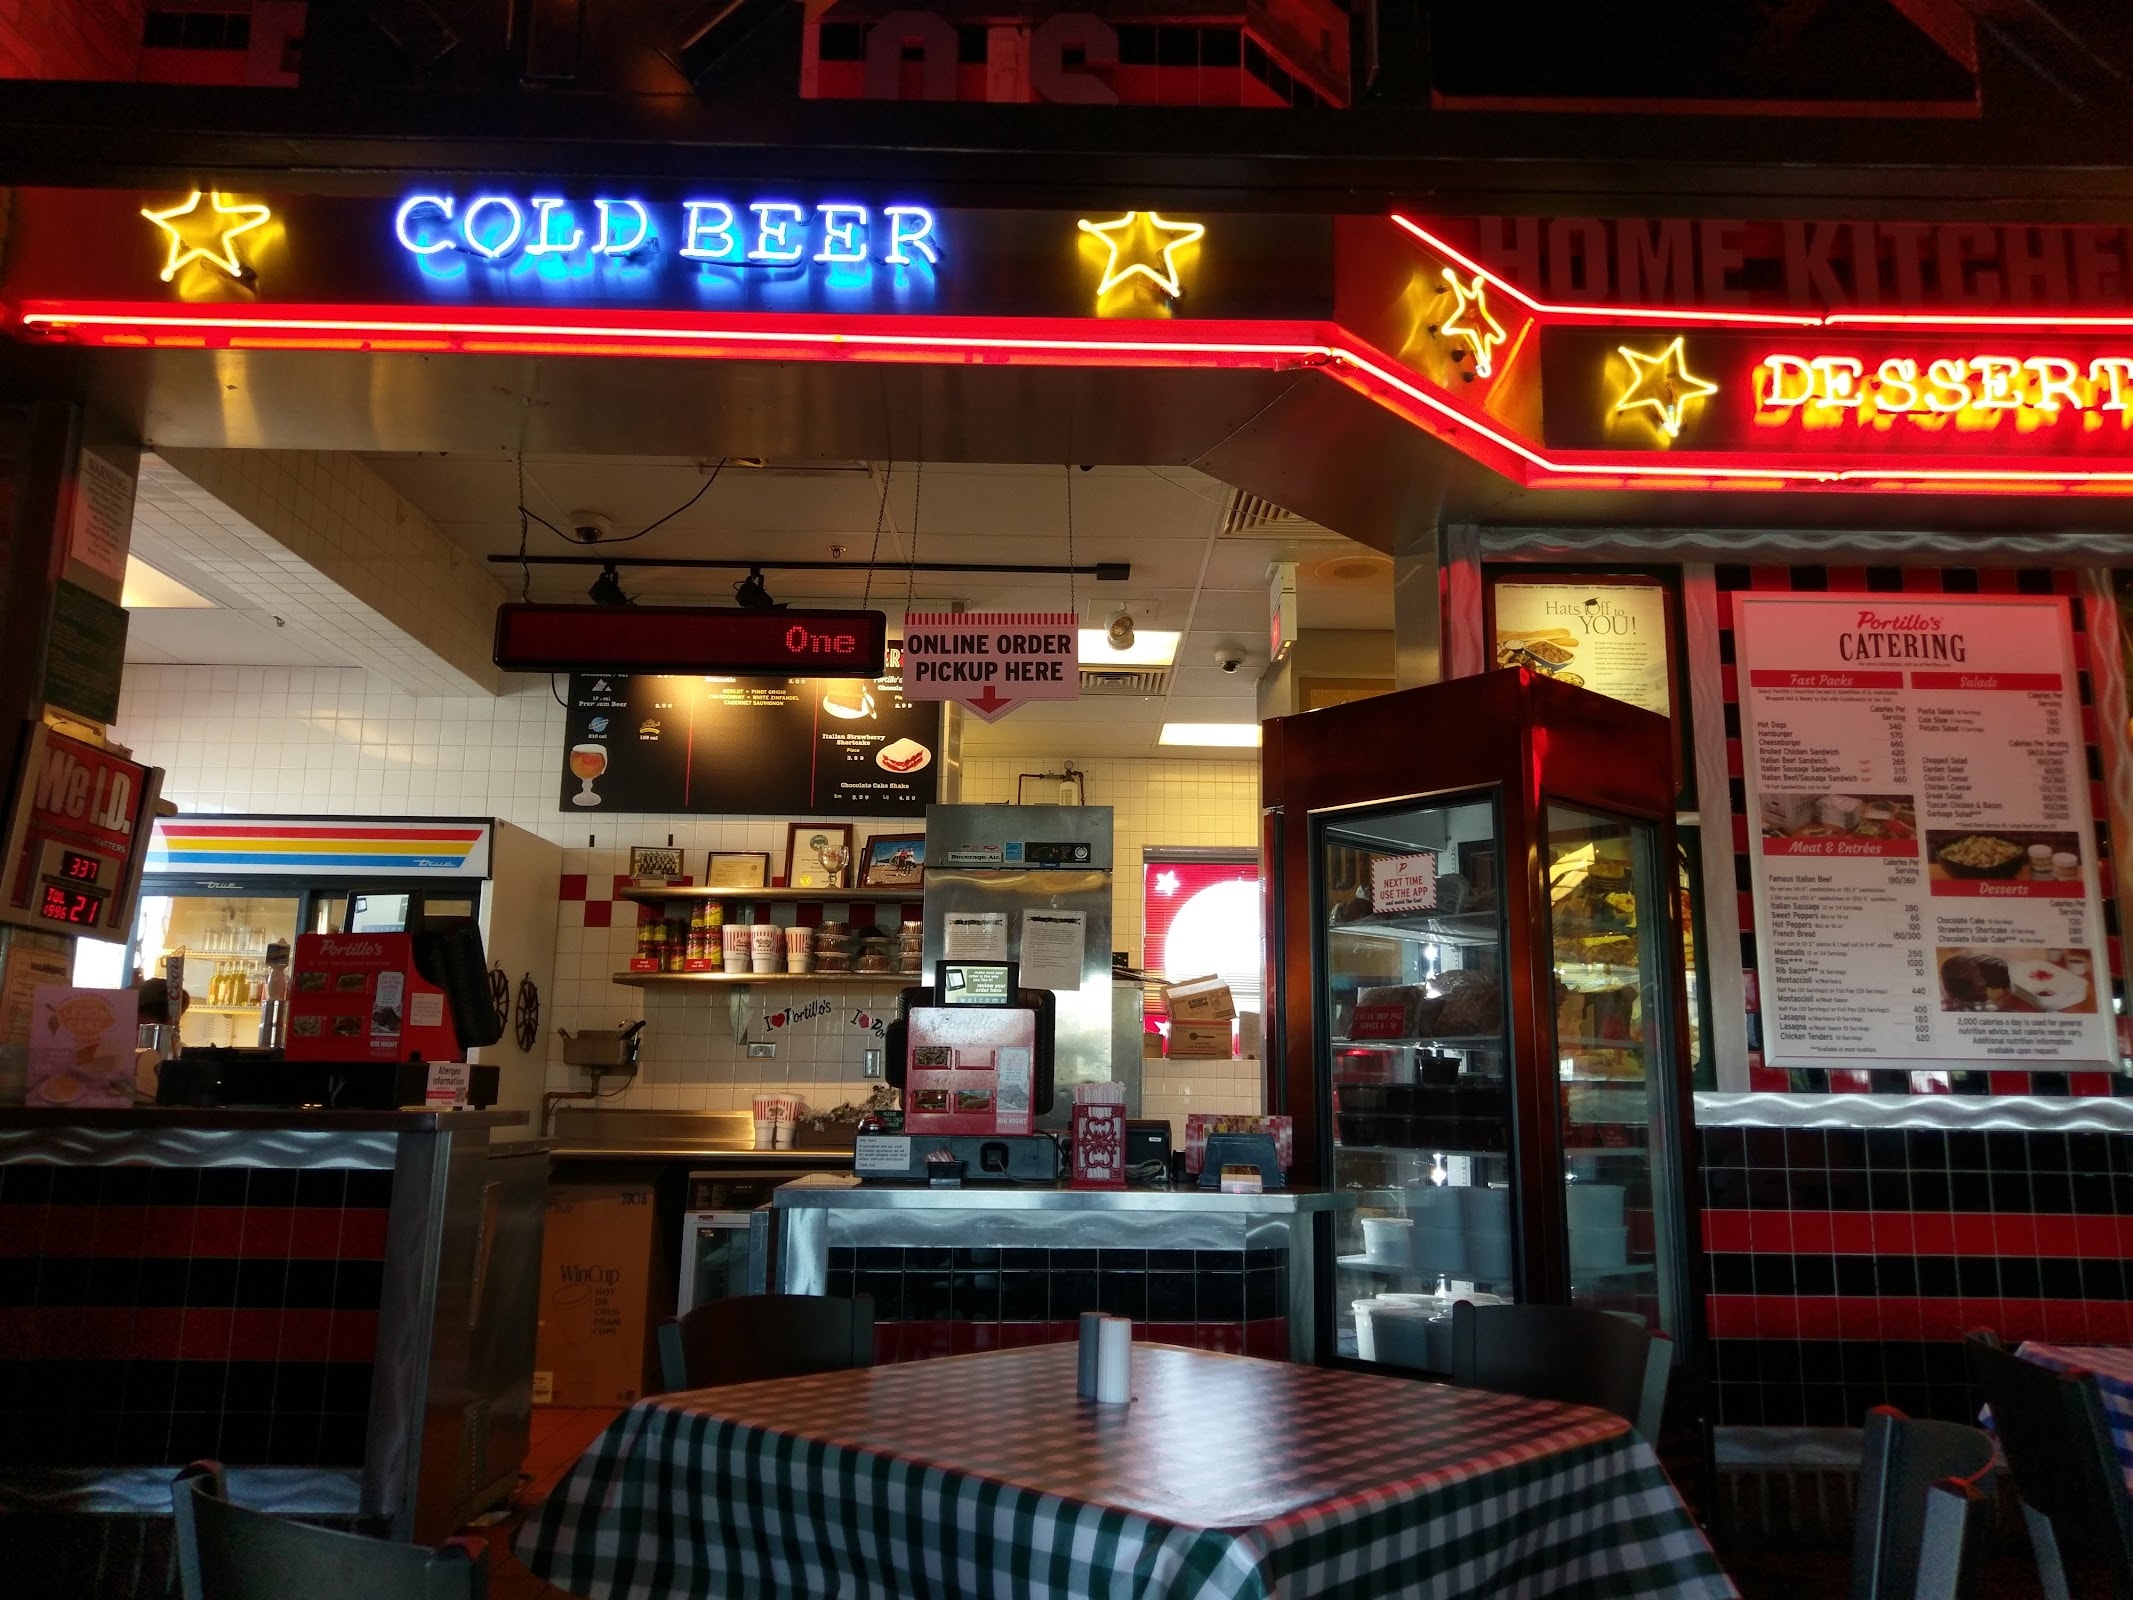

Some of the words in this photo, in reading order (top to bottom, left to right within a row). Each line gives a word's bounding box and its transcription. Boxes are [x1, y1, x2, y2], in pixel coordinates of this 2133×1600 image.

[396, 196, 648, 258] COLD
[679, 201, 937, 264] BEER
[1481, 217, 1747, 306] HOME
[1781, 223, 2133, 309] KITCHE
[1763, 355, 2133, 412] DESSERT
[1545, 601, 1580, 615] Hats
[1584, 600, 1610, 616] Off
[1615, 608, 1624, 616] to
[1578, 615, 1637, 635] YOU!
[1856, 610, 1941, 631] Portillo's
[786, 626, 855, 653] One
[908, 634, 989, 654] ONLINE
[997, 635, 1071, 654] ORDER
[1840, 632, 1966, 663] CATERING
[916, 661, 998, 681] PICKUP
[1005, 661, 1063, 681] HERE
[1790, 673, 1817, 687] Fast
[1819, 674, 1853, 687] Packs
[1959, 676, 1998, 688] Salads
[1922, 757, 1948, 765] Chopped
[36, 750, 90, 818] We
[89, 765, 131, 835] I.D.
[1788, 841, 1822, 854] Meat
[1825, 842, 1833, 853] &
[69, 857, 98, 880] 337
[1384, 878, 1402, 888] NEXT
[1405, 876, 1423, 886] TIME
[1769, 875, 1794, 883] Famous
[1380, 890, 1394, 899] USE
[1396, 889, 1410, 898] THE
[1413, 887, 1428, 896] APP
[1979, 882, 2029, 895] Desserts
[43, 904, 67, 919] 1996
[69, 895, 98, 923] 21
[1793, 903, 1819, 911] Sausage
[1793, 912, 1819, 920] Peppers
[1772, 921, 1784, 929] Hot
[1786, 921, 1812, 930] Peppers
[1938, 926, 1973, 934] Strawberry
[1773, 930, 1795, 938] French
[1797, 930, 1816, 938] Bread
[1938, 935, 1969, 943] Chocolate
[320, 938, 383, 956] Portillo's
[1776, 967, 1786, 975] Rib
[1776, 976, 1812, 984] Mostaccioli
[1778, 995, 1814, 1003] Mostaccioli
[764, 1015, 773, 1032] I
[784, 1000, 831, 1025] Portillo's
[1779, 1014, 1806, 1022] Lasagna
[1979, 1018, 2003, 1026] calories
[1780, 1023, 1807, 1032] Lasagna
[1780, 1033, 1806, 1041] Chicken
[1808, 1033, 1833, 1041] Tenders
[438, 1066, 461, 1076] Allergen
[560, 1265, 620, 1286] WinCup
[593, 1328, 617, 1336] CUPS
